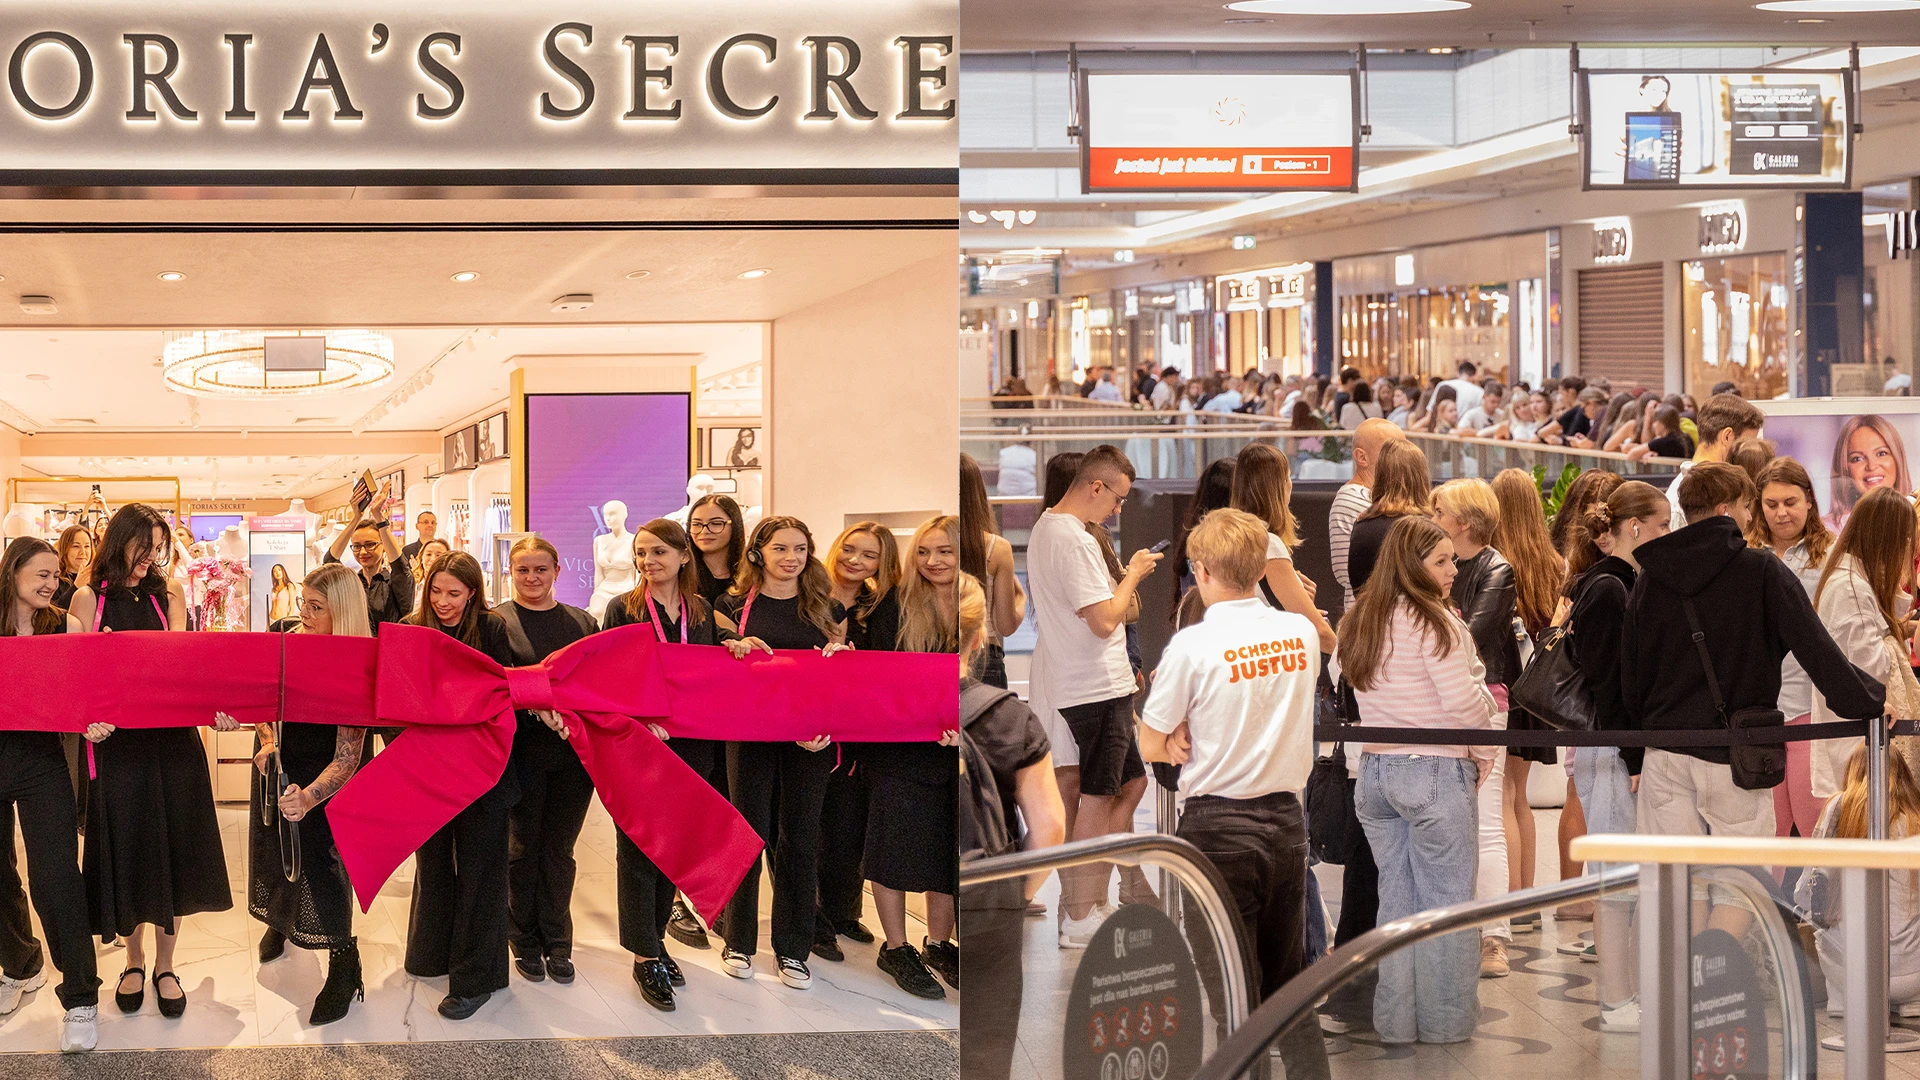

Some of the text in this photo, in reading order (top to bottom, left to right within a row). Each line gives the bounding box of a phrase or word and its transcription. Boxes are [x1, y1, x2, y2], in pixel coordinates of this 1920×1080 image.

[8, 23, 466, 121] ORIA'S
[1224, 638, 1305, 662] OCHRONA
[1229, 652, 1307, 683] JUSTUS
